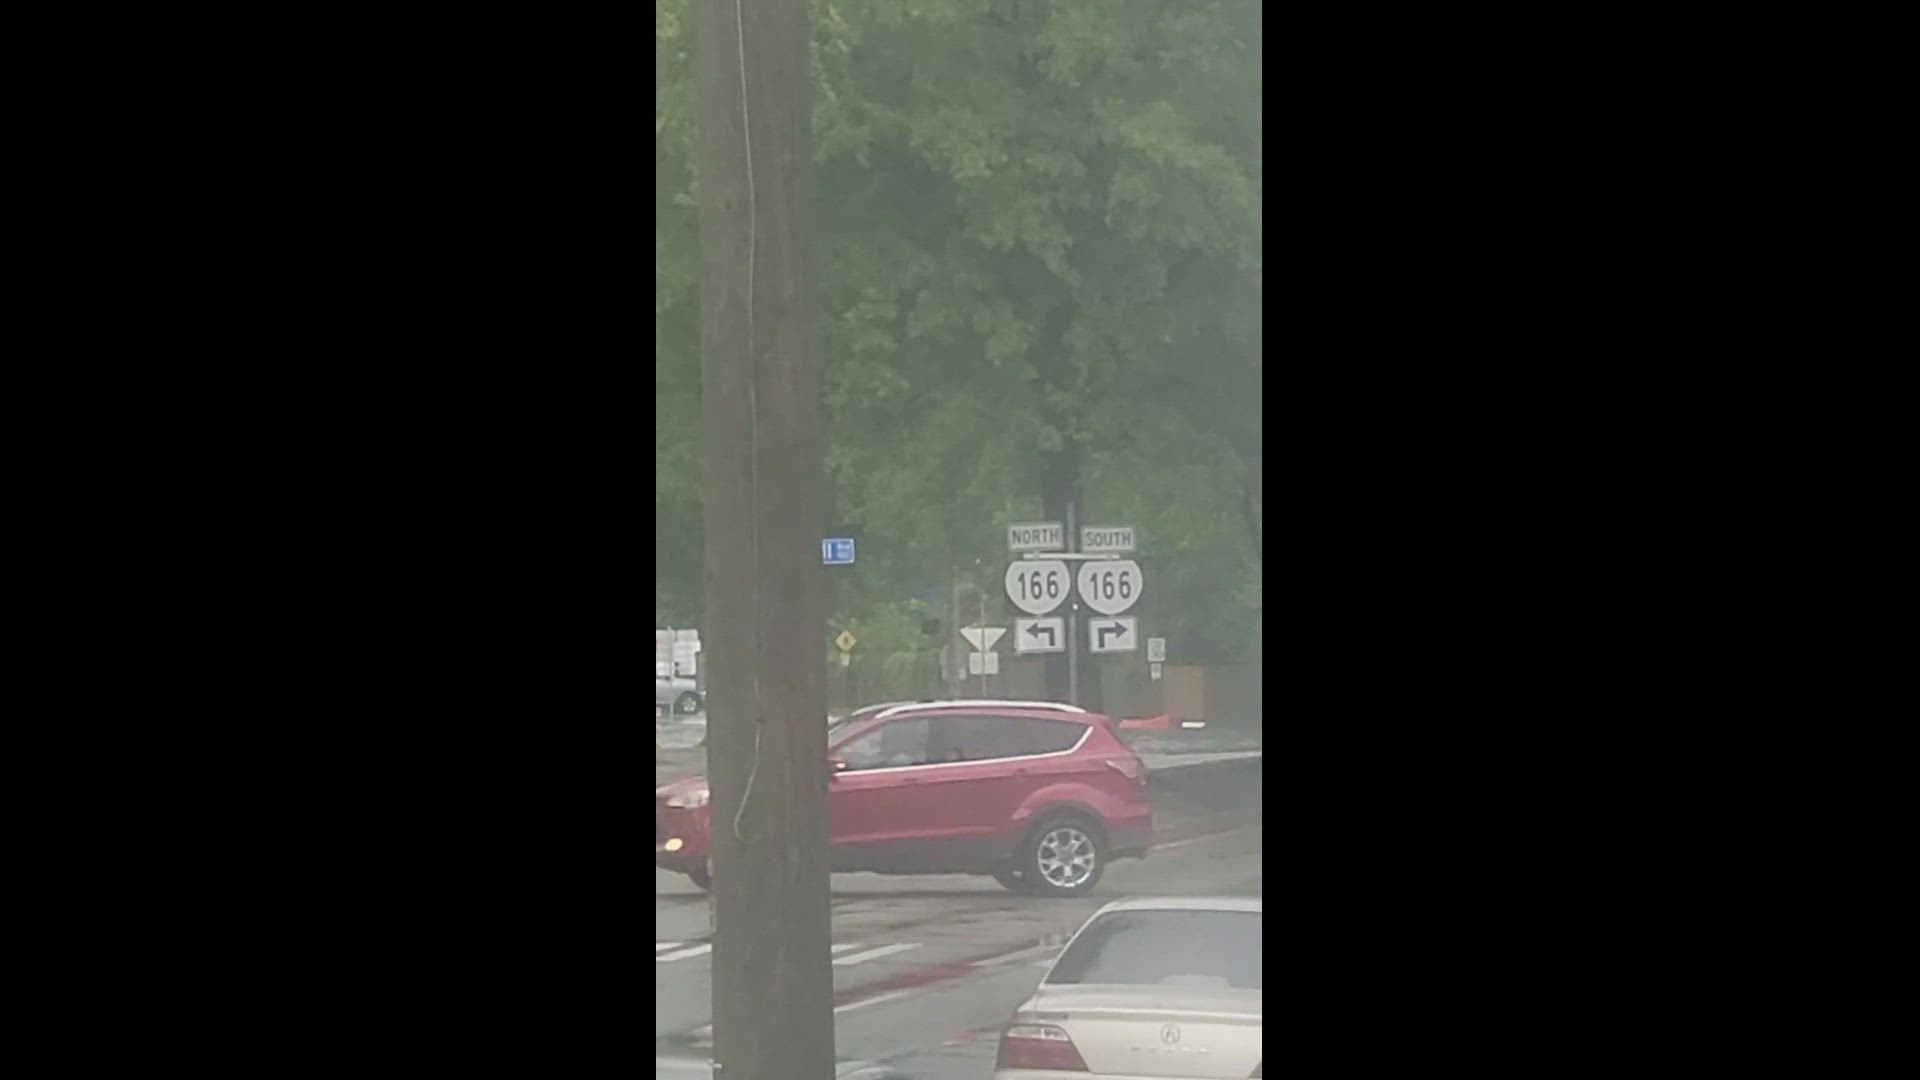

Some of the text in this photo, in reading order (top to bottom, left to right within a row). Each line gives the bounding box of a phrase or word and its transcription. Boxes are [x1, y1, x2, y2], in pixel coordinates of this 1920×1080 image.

[1012, 528, 1059, 544] NORTH
[1085, 531, 1131, 547] SOUTH
[1018, 570, 1059, 600] 166
[1090, 570, 1131, 600] 166
